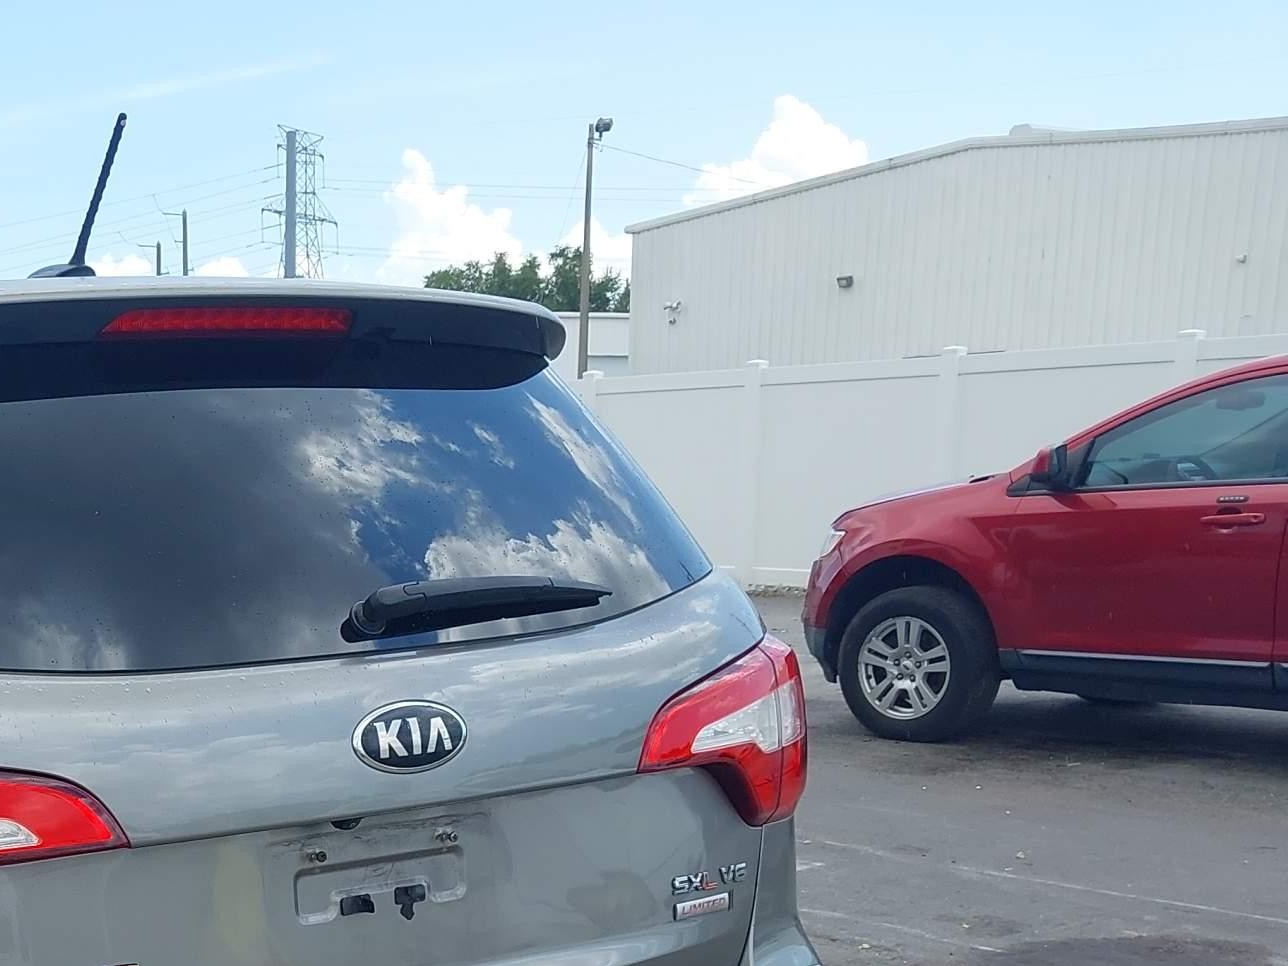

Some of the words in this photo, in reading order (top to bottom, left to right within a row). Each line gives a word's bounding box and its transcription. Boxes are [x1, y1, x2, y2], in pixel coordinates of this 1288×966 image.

[373, 716, 453, 759] KIA
[671, 871, 718, 896] SXL
[680, 897, 726, 915] LIMITED
